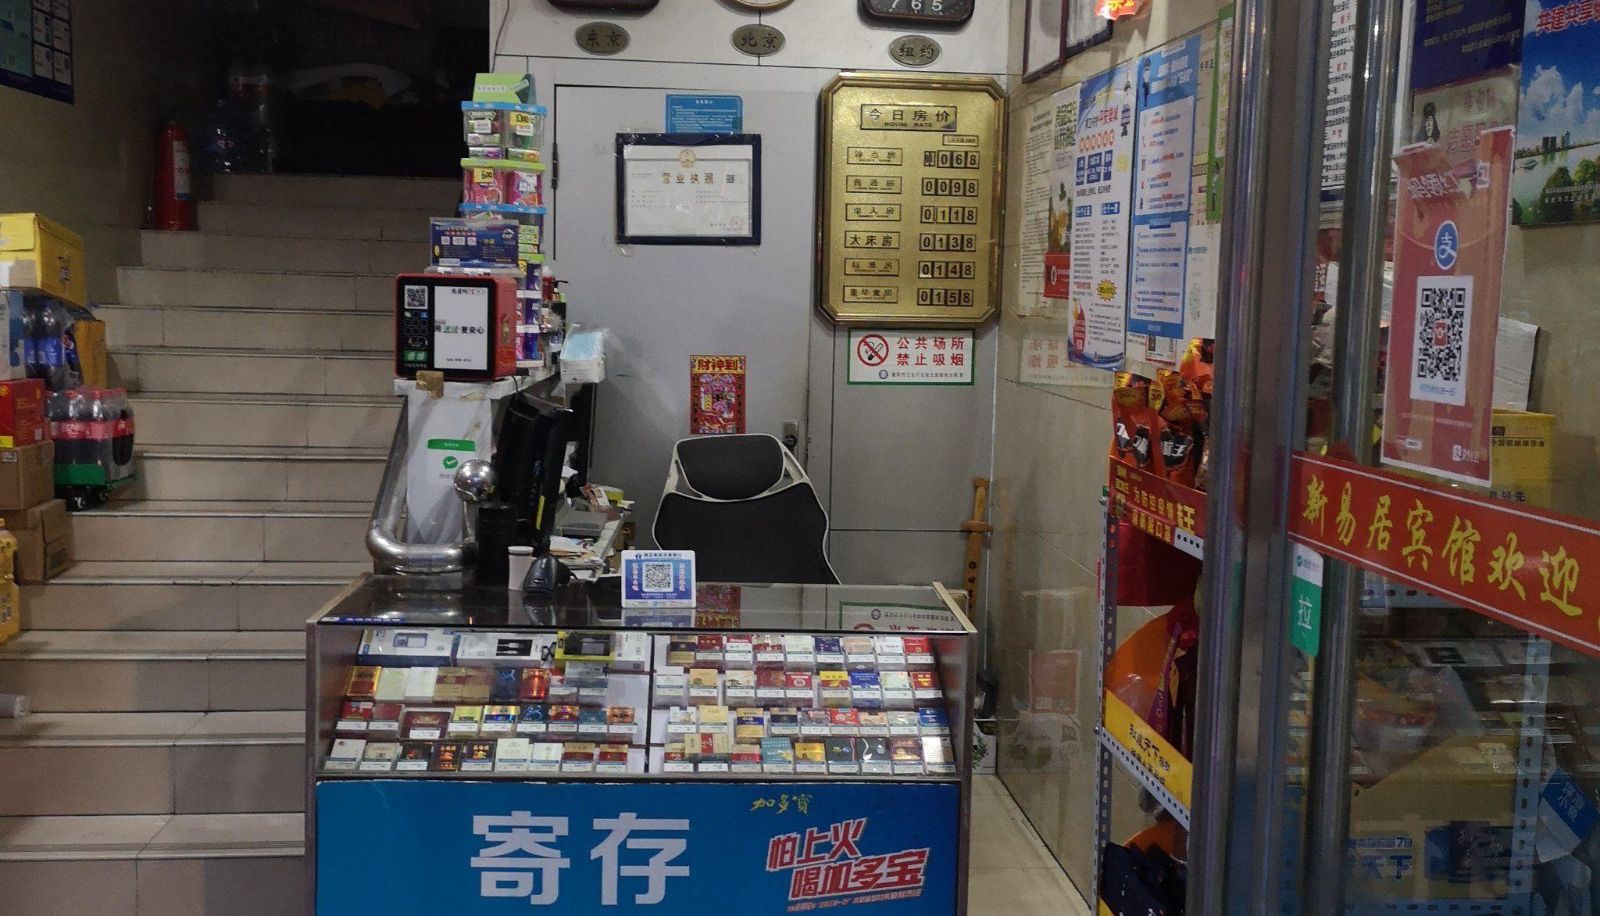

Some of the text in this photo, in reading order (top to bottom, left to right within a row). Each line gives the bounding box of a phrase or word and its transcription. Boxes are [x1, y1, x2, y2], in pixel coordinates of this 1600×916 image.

[740, 31, 777, 49] 北京
[898, 43, 935, 59] 纽约
[868, 108, 950, 122] 今日房价
[925, 181, 976, 195] 0098
[924, 208, 975, 222] 0118
[849, 234, 893, 247] 大床房
[922, 235, 974, 249] 0138
[921, 264, 973, 277] 0148
[920, 289, 971, 304] 0158
[897, 337, 964, 350] 公共场所
[896, 353, 964, 366] 禁止吸烟
[1303, 475, 1583, 616] 新易居宾馆欢迎
[1298, 594, 1312, 629] 拉
[766, 818, 866, 872] 怕上火
[470, 811, 689, 905] 寄存
[789, 848, 929, 900] 喝加多宝
